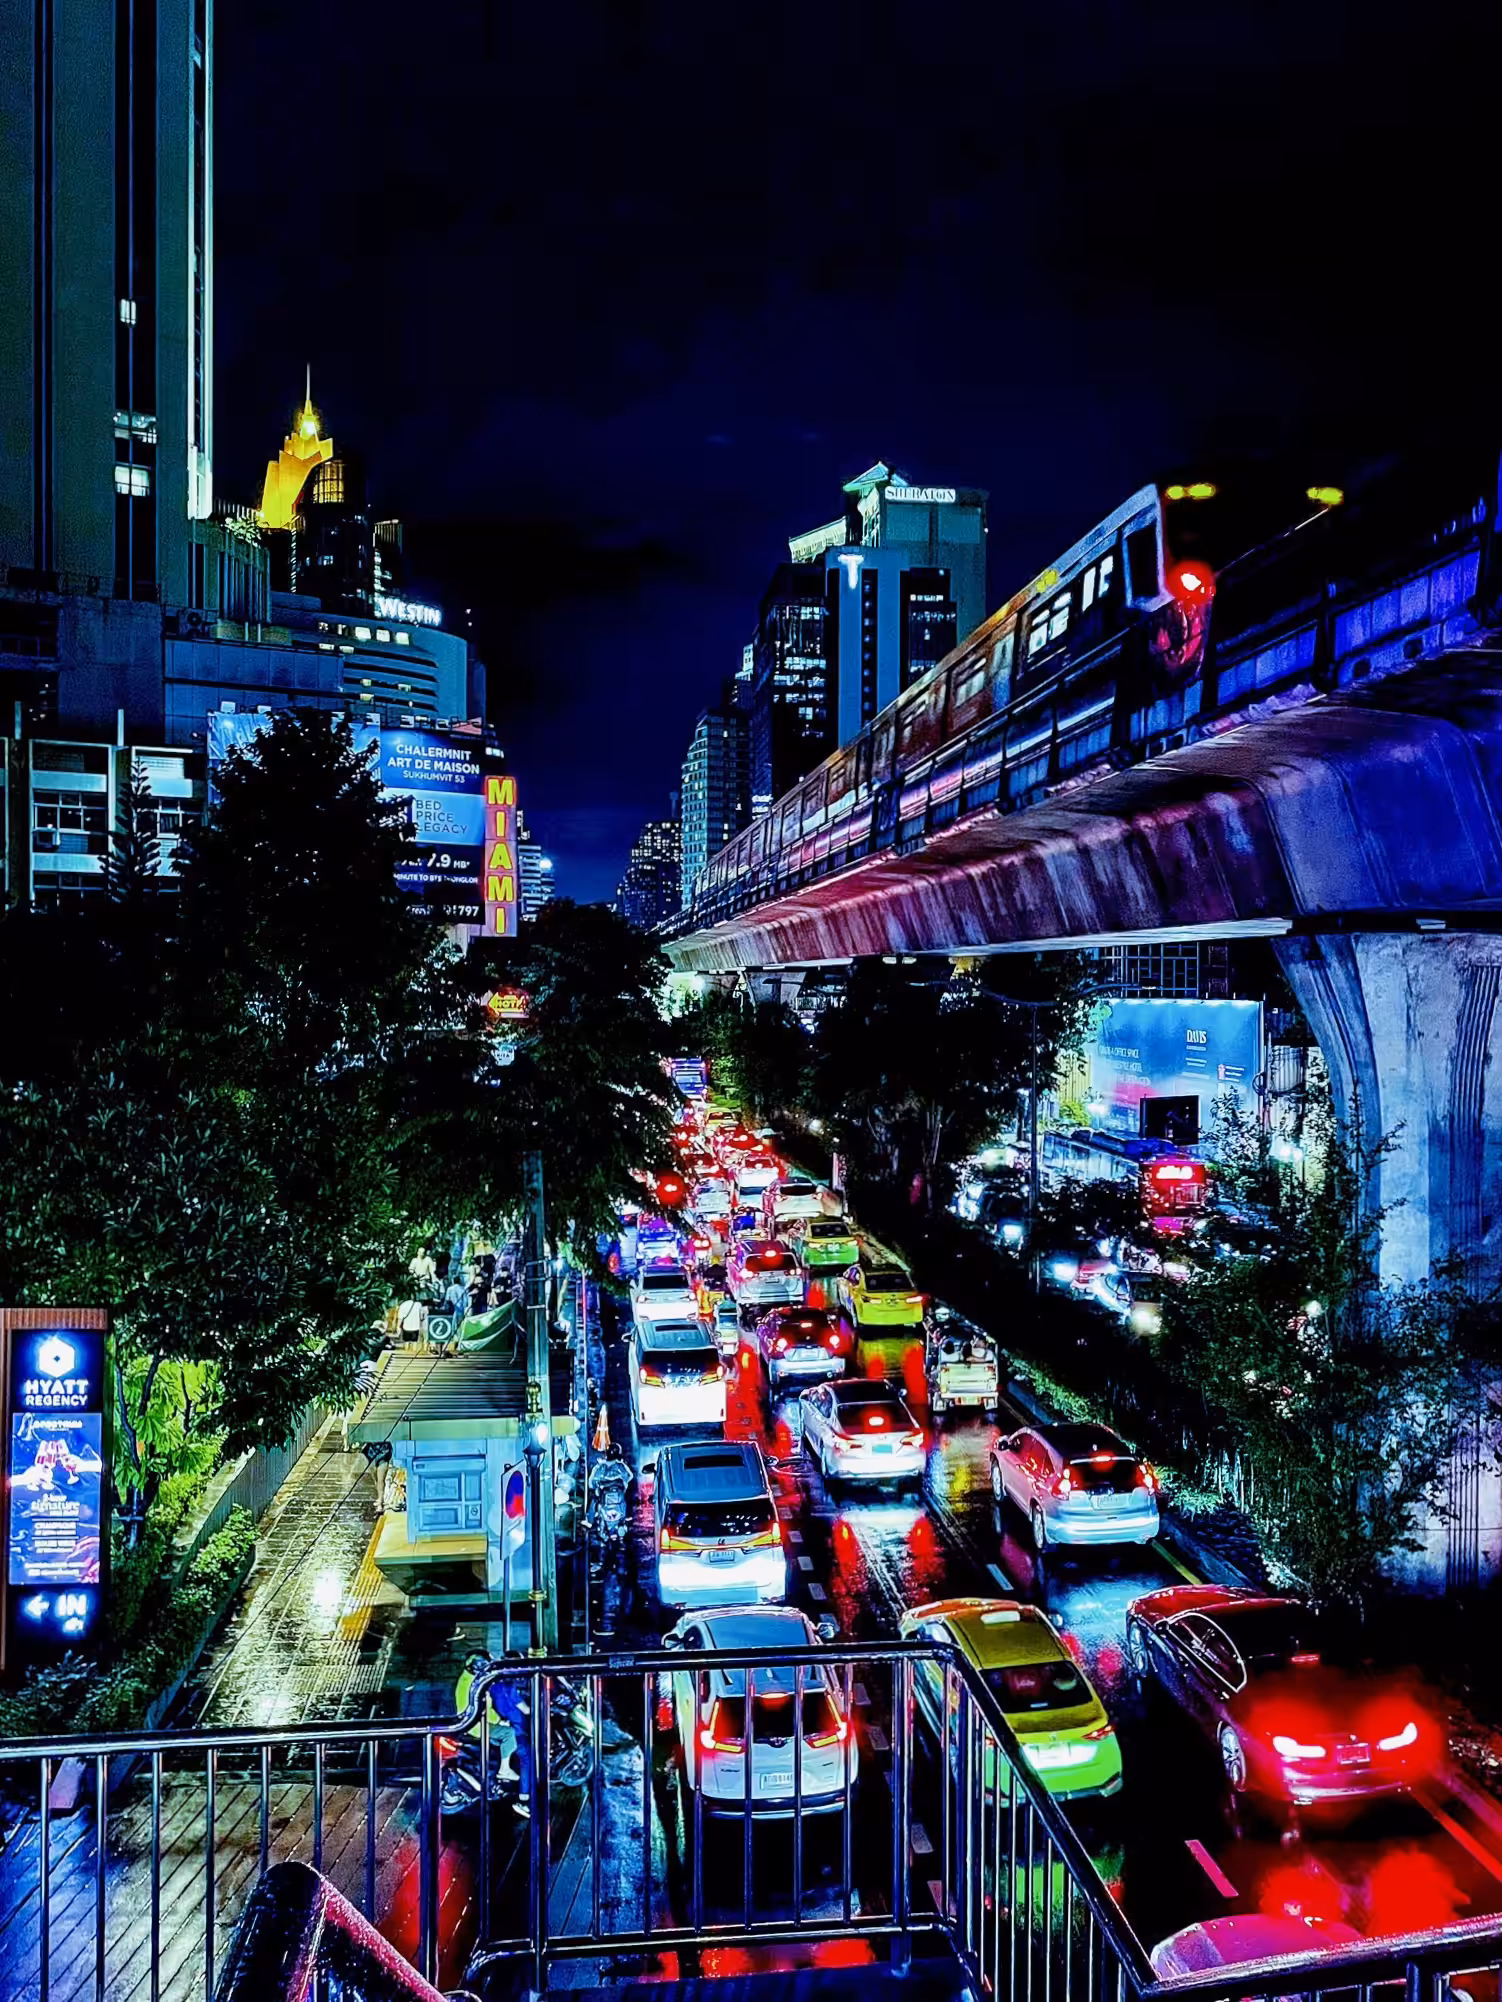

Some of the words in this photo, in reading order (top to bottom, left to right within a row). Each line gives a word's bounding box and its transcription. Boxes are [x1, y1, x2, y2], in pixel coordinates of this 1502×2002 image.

[885, 486, 956, 503] SHERATON
[378, 596, 442, 626] WESTIN
[396, 744, 472, 761] CHALERMNIT
[387, 757, 412, 769] ART
[414, 759, 431, 770] DE
[434, 761, 480, 775] MAISON
[403, 770, 453, 781] SUKHUMVIT
[454, 775, 465, 783] 53
[416, 800, 441, 812] BED
[416, 811, 454, 823] PRICE
[417, 822, 468, 834] LEGACY
[487, 777, 514, 935] MIAMI
[25, 1379, 89, 1395] HYATT
[25, 1395, 88, 1407] REGENCY
[57, 1594, 87, 1617] IN
